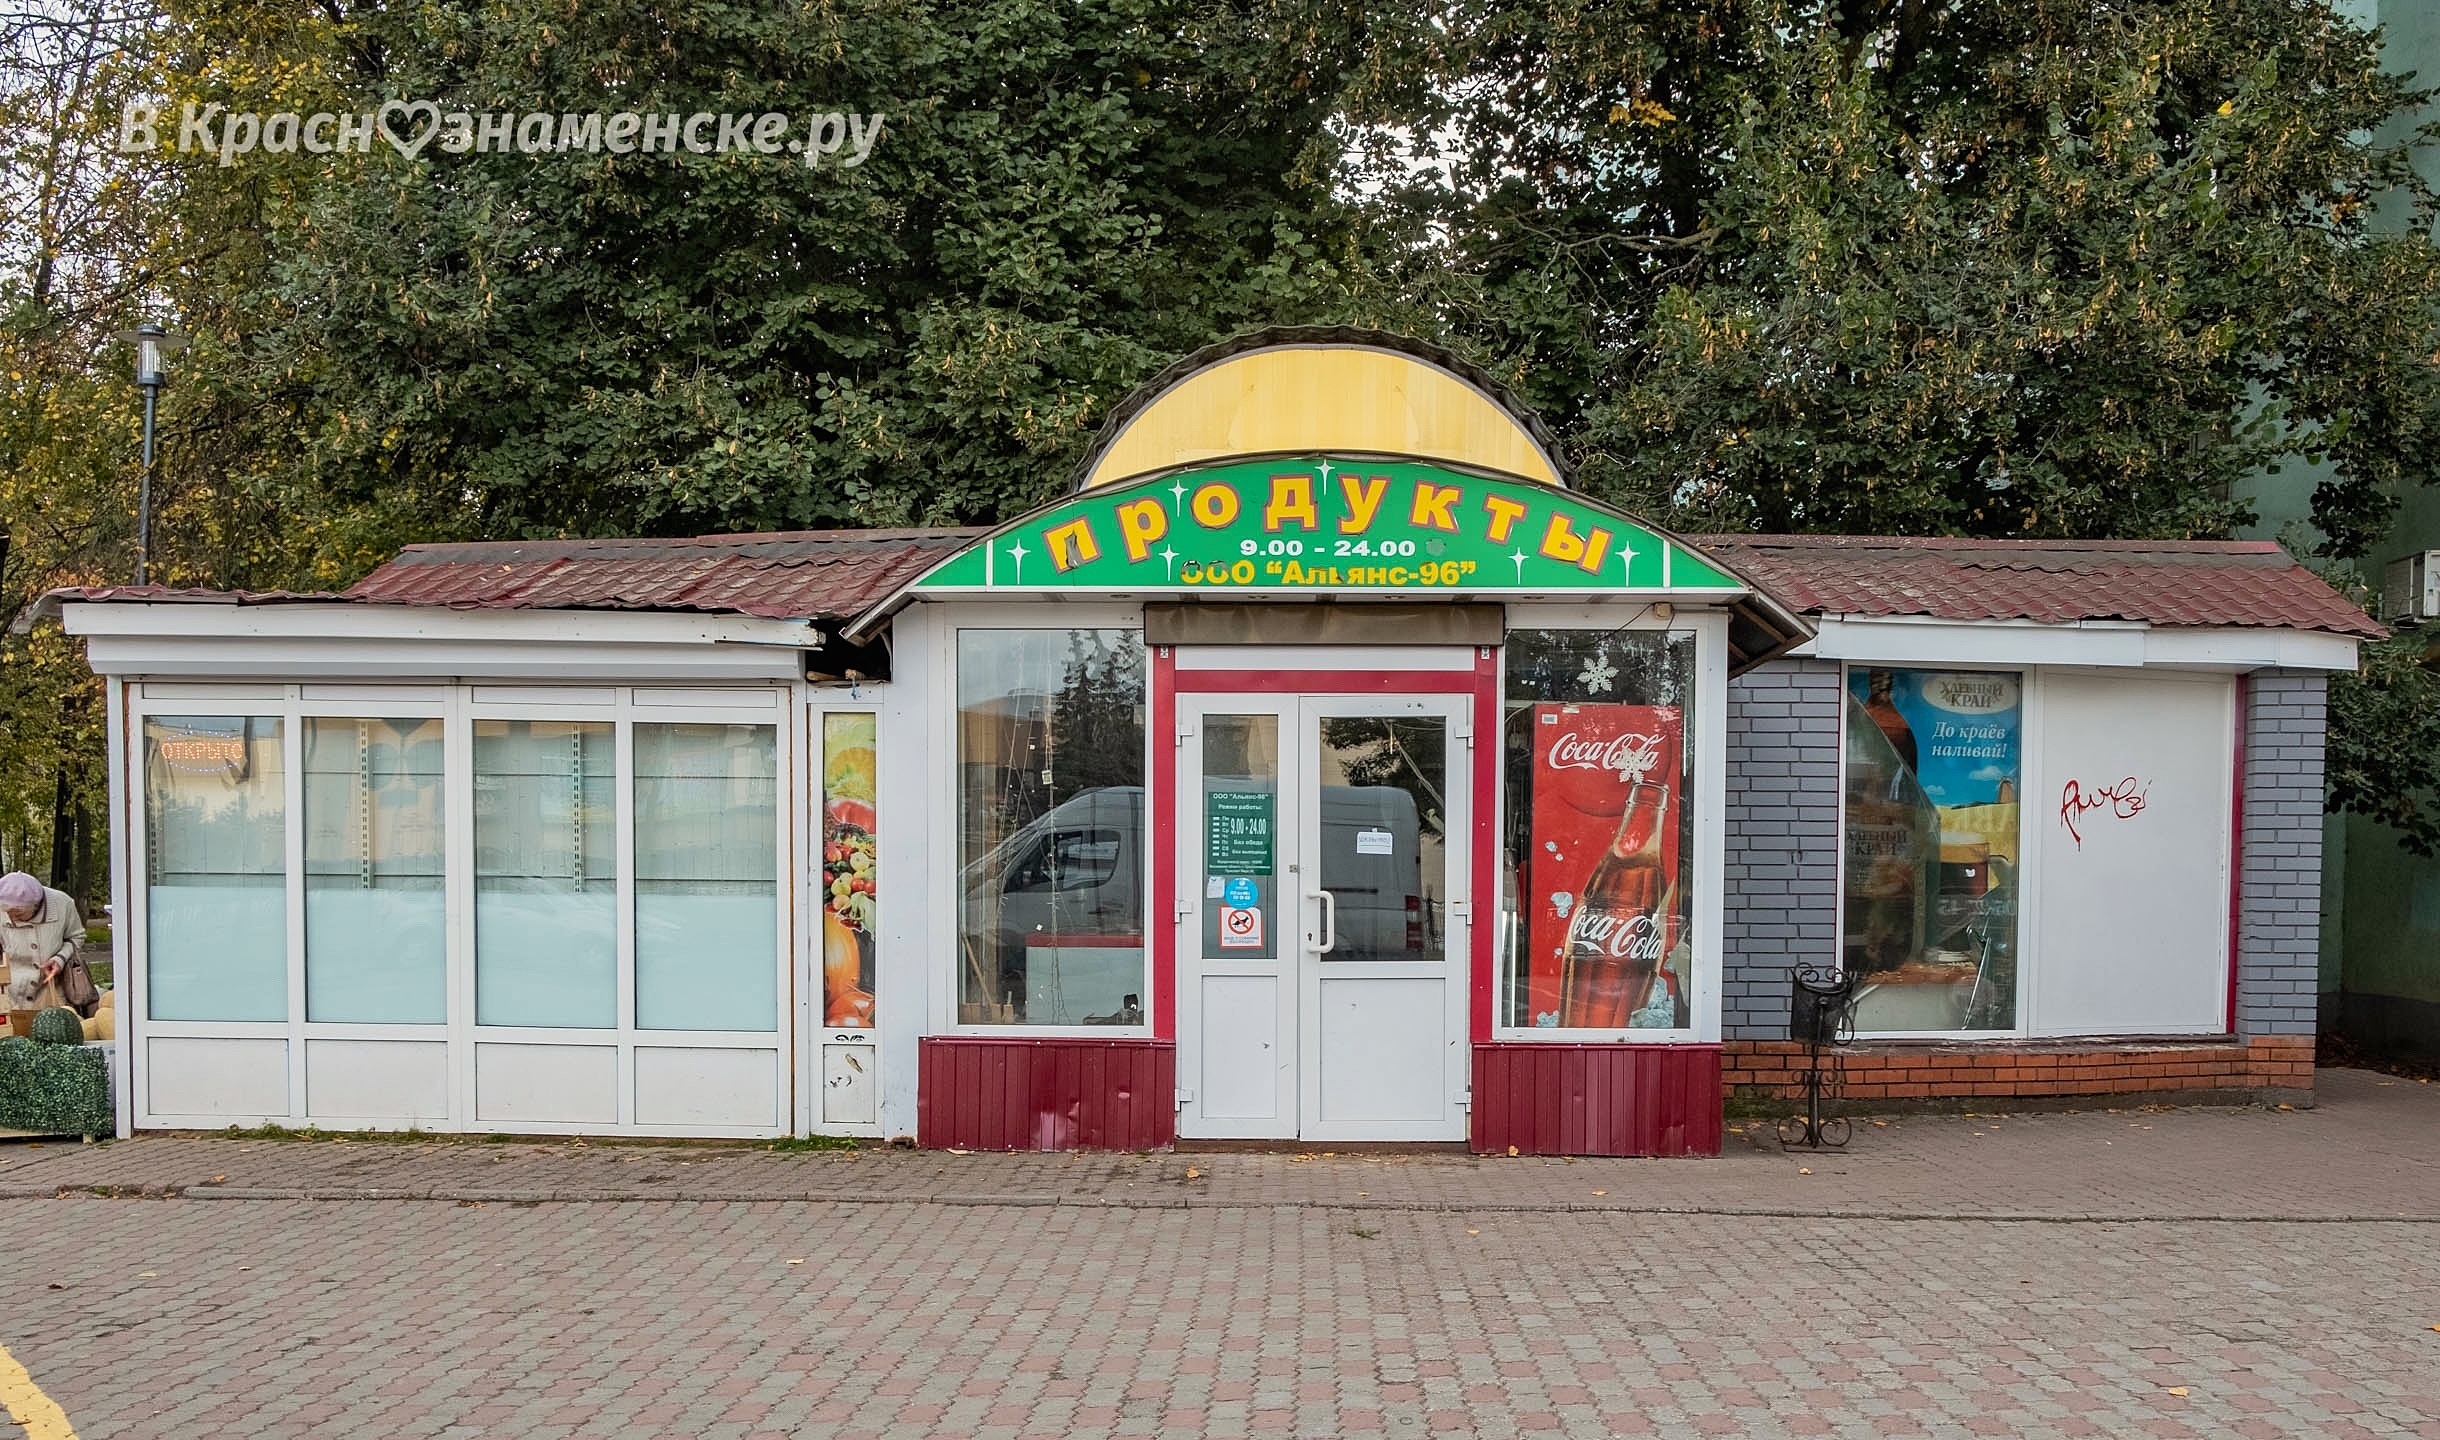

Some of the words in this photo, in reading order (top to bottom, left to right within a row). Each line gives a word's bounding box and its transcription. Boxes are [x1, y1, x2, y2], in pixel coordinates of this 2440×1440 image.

[1240, 540, 1303, 556] 9.00
[1334, 540, 1416, 556] 24.00
[1180, 559, 1255, 584] ООО
[1932, 721, 1955, 740] До
[1959, 724, 2006, 743] краёв
[161, 742, 243, 760] ОТКРЫТО
[1549, 732, 1666, 770] Coca-Cola
[1932, 743, 2007, 758] наливай!
[1230, 818, 1245, 835] 9.00
[1249, 818, 1267, 835] 24.00
[1569, 905, 1663, 960] Coca-Cola
